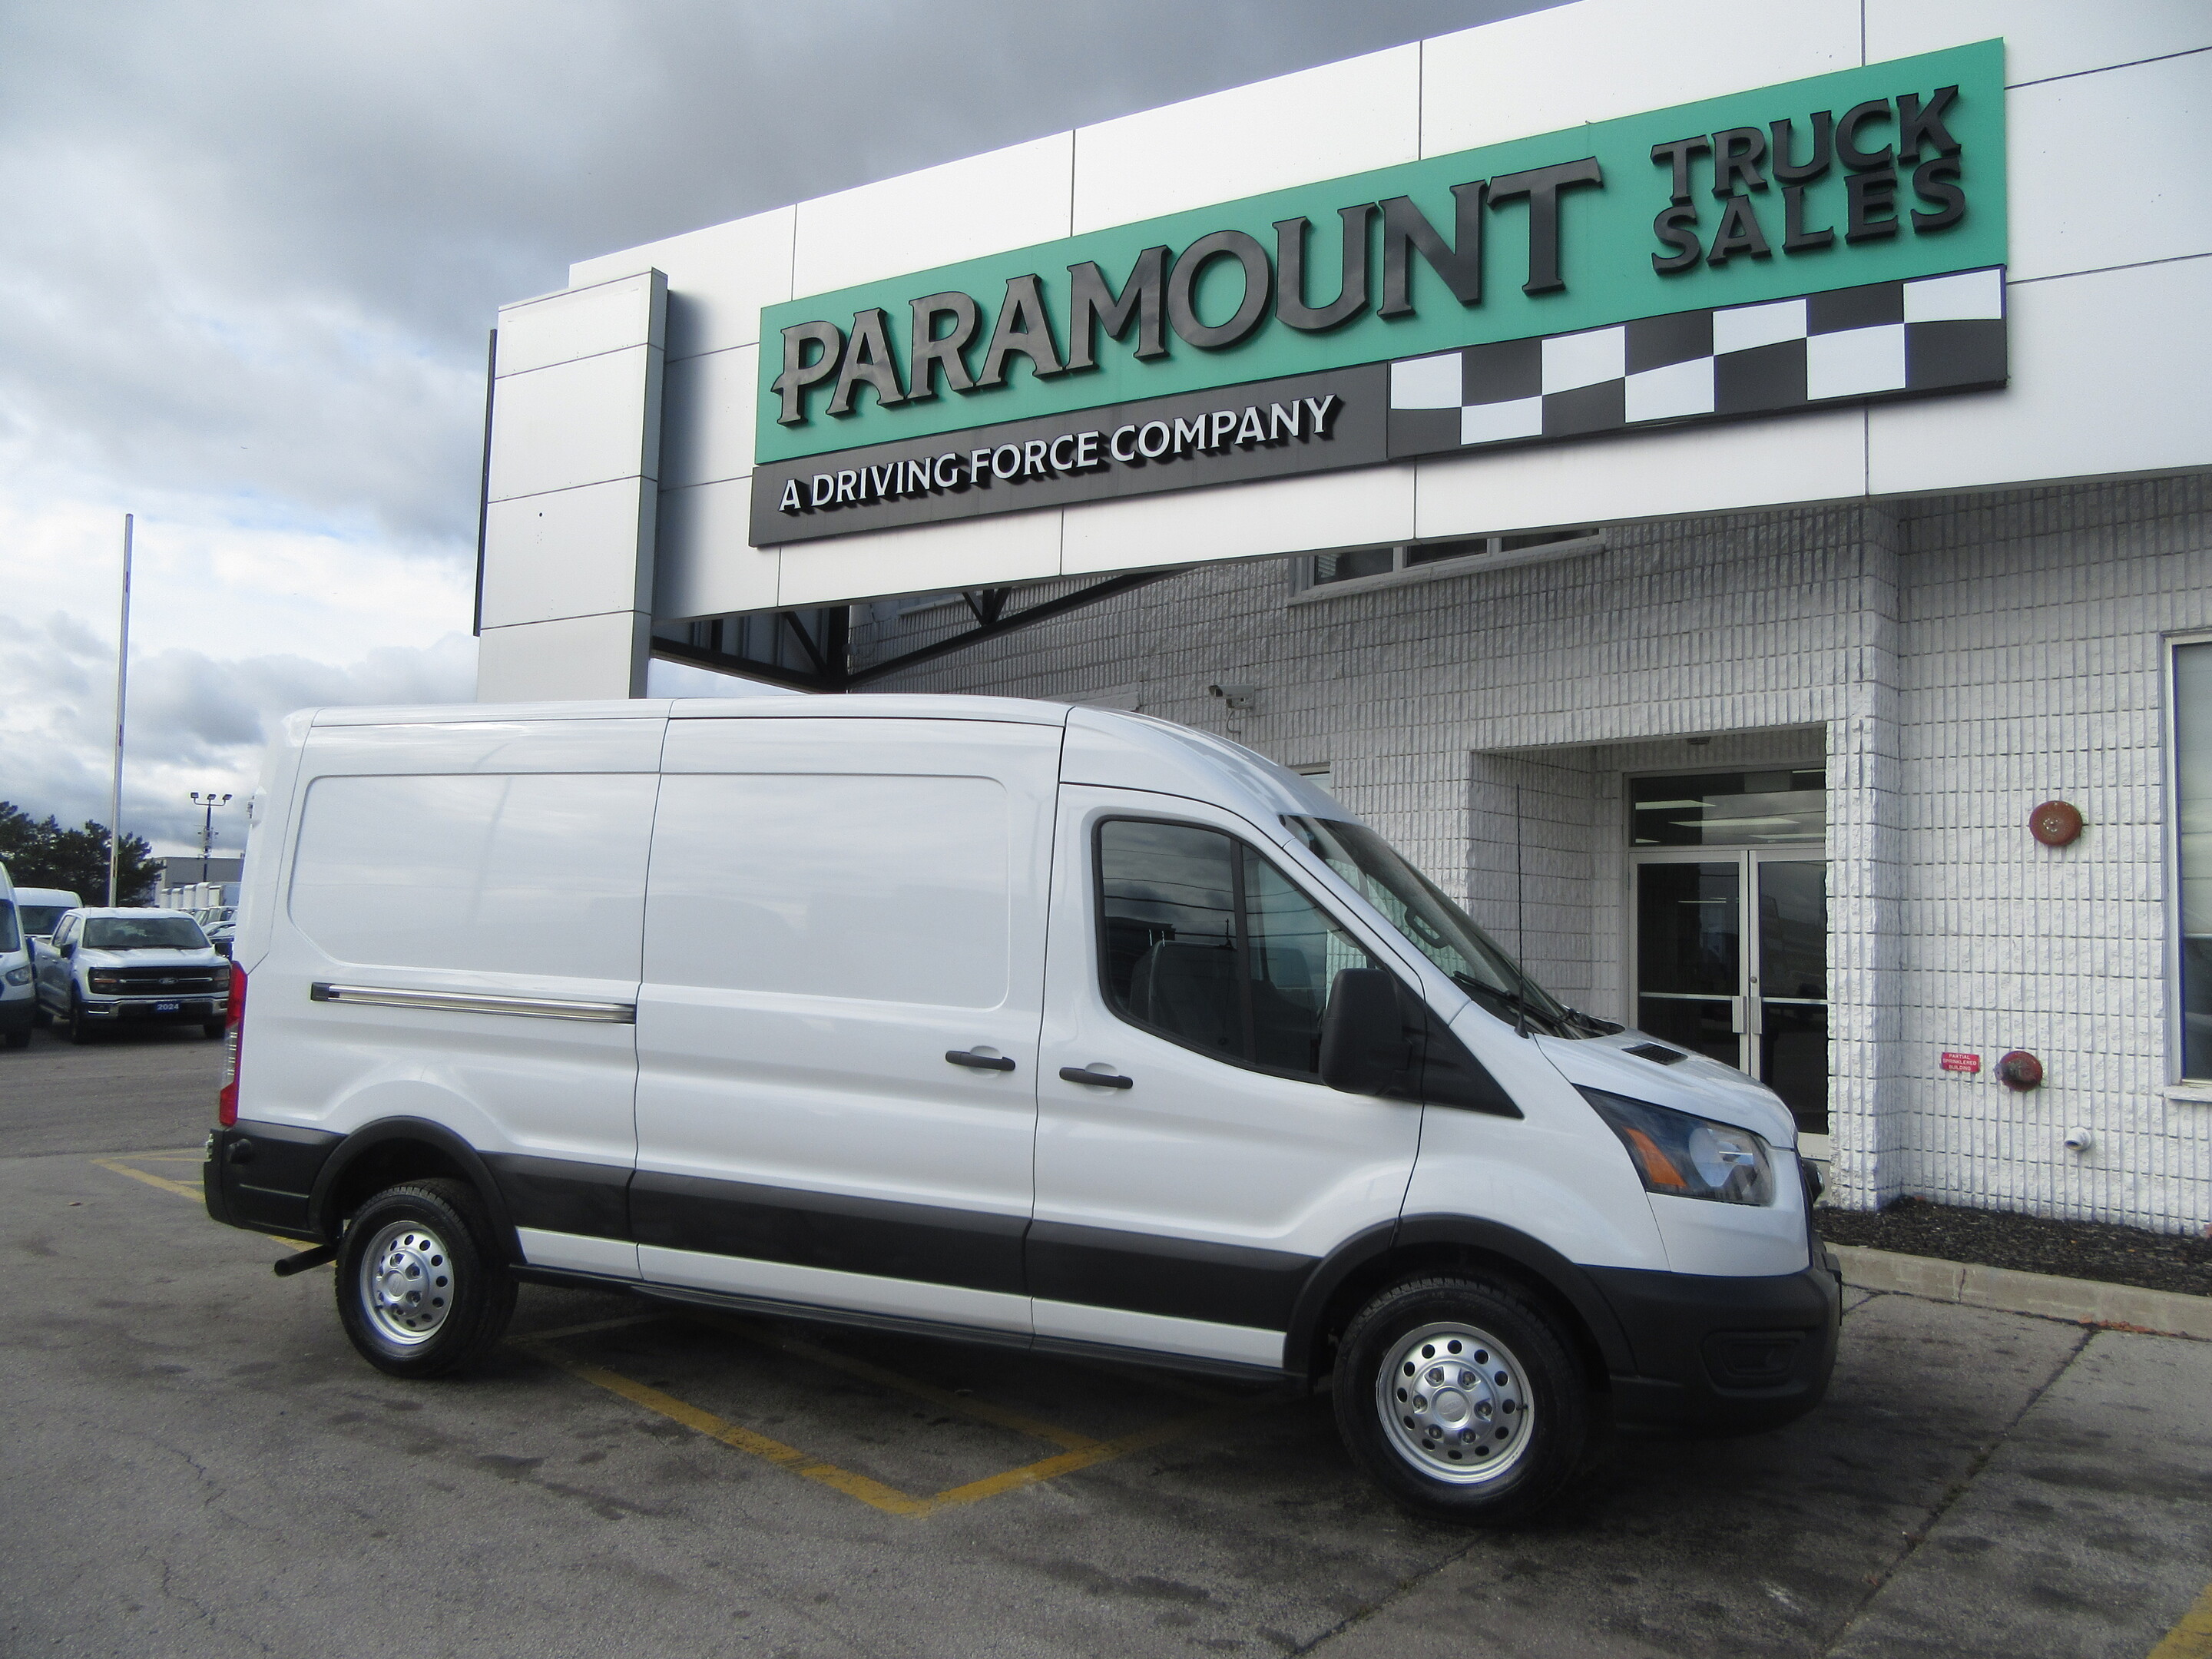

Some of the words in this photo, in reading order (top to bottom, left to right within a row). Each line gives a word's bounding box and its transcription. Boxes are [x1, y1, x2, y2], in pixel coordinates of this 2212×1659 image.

[1650, 84, 1962, 205] TRUCK
[1651, 156, 1965, 275] SALES
[770, 156, 1604, 426] PARAMOUNT
[778, 478, 801, 511] A
[811, 452, 958, 507] DRIVING
[970, 430, 1099, 484] FORCE
[1110, 394, 1336, 462] COMPANY
